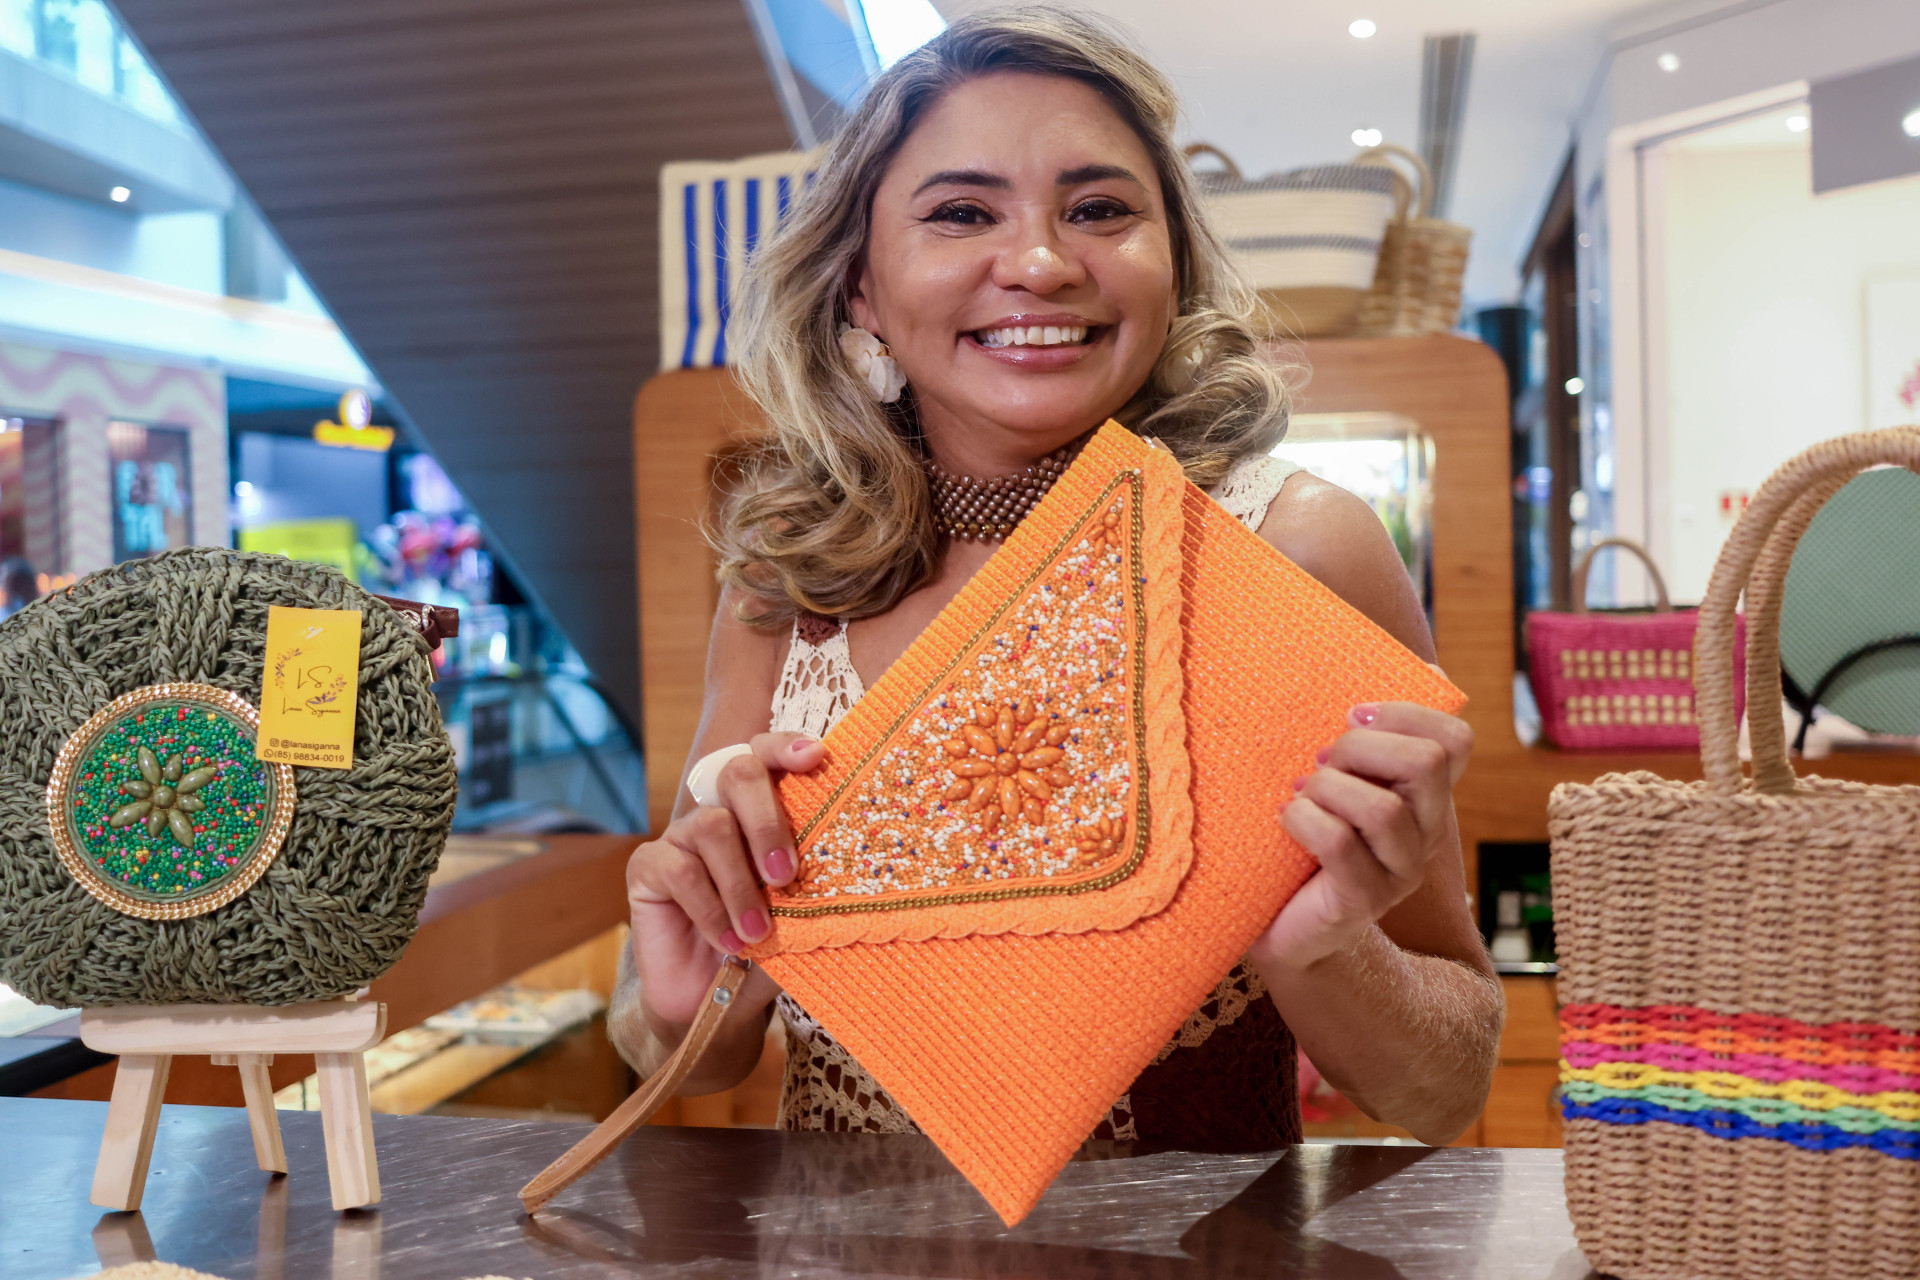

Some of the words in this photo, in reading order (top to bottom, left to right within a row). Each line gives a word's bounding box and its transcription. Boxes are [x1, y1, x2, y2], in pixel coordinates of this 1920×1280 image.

[281, 739, 341, 751] @lanasiganna
[274, 750, 292, 761] (85)
[293, 752, 345, 763] 98834-0019
